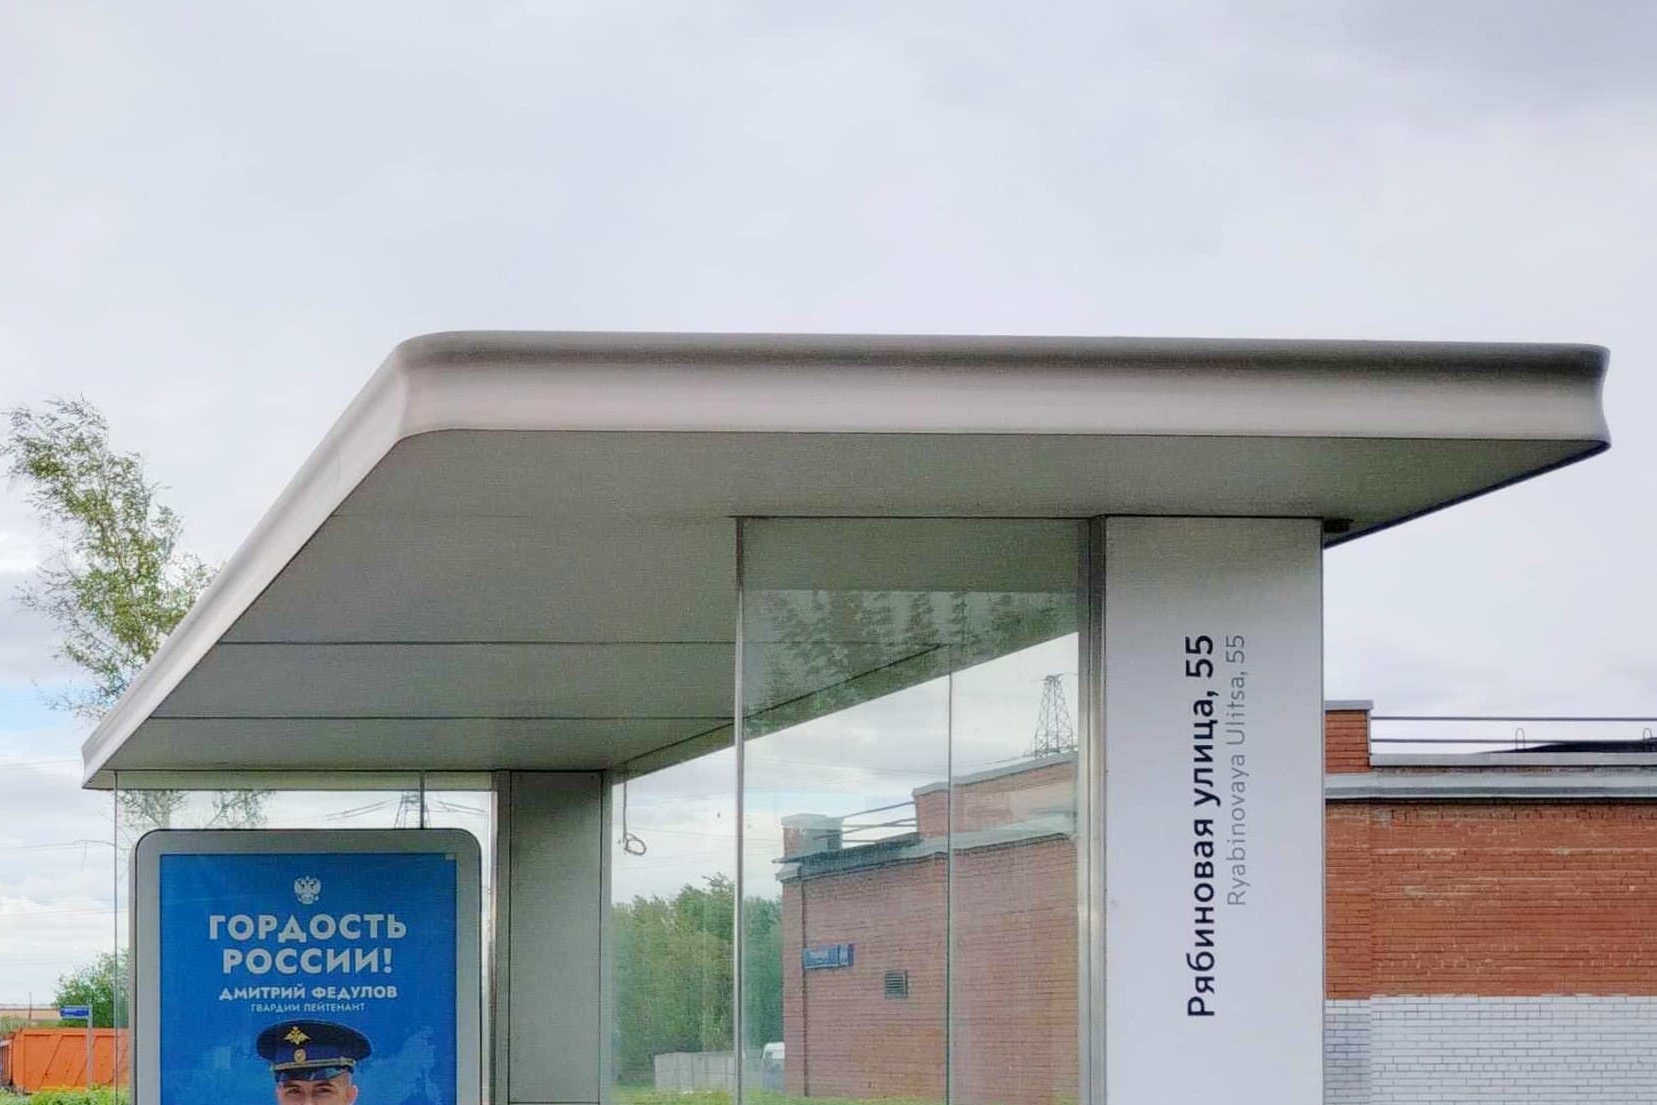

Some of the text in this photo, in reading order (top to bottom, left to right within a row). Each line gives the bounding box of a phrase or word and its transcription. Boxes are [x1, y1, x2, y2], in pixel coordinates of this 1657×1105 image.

[1225, 634, 1251, 905] Ryabinovaya Ulitsa, 55
[1185, 635, 1222, 1017] Рябиновая улица, 55
[209, 914, 407, 943] ГОРДОСТЬ
[222, 948, 393, 974] РОССИИ!
[219, 984, 398, 1001] ДМИТРИЙ ФЕДУЛОВ
[251, 1002, 366, 1013] ГВАРДИИ ЛЕЙТЕНАНТ
